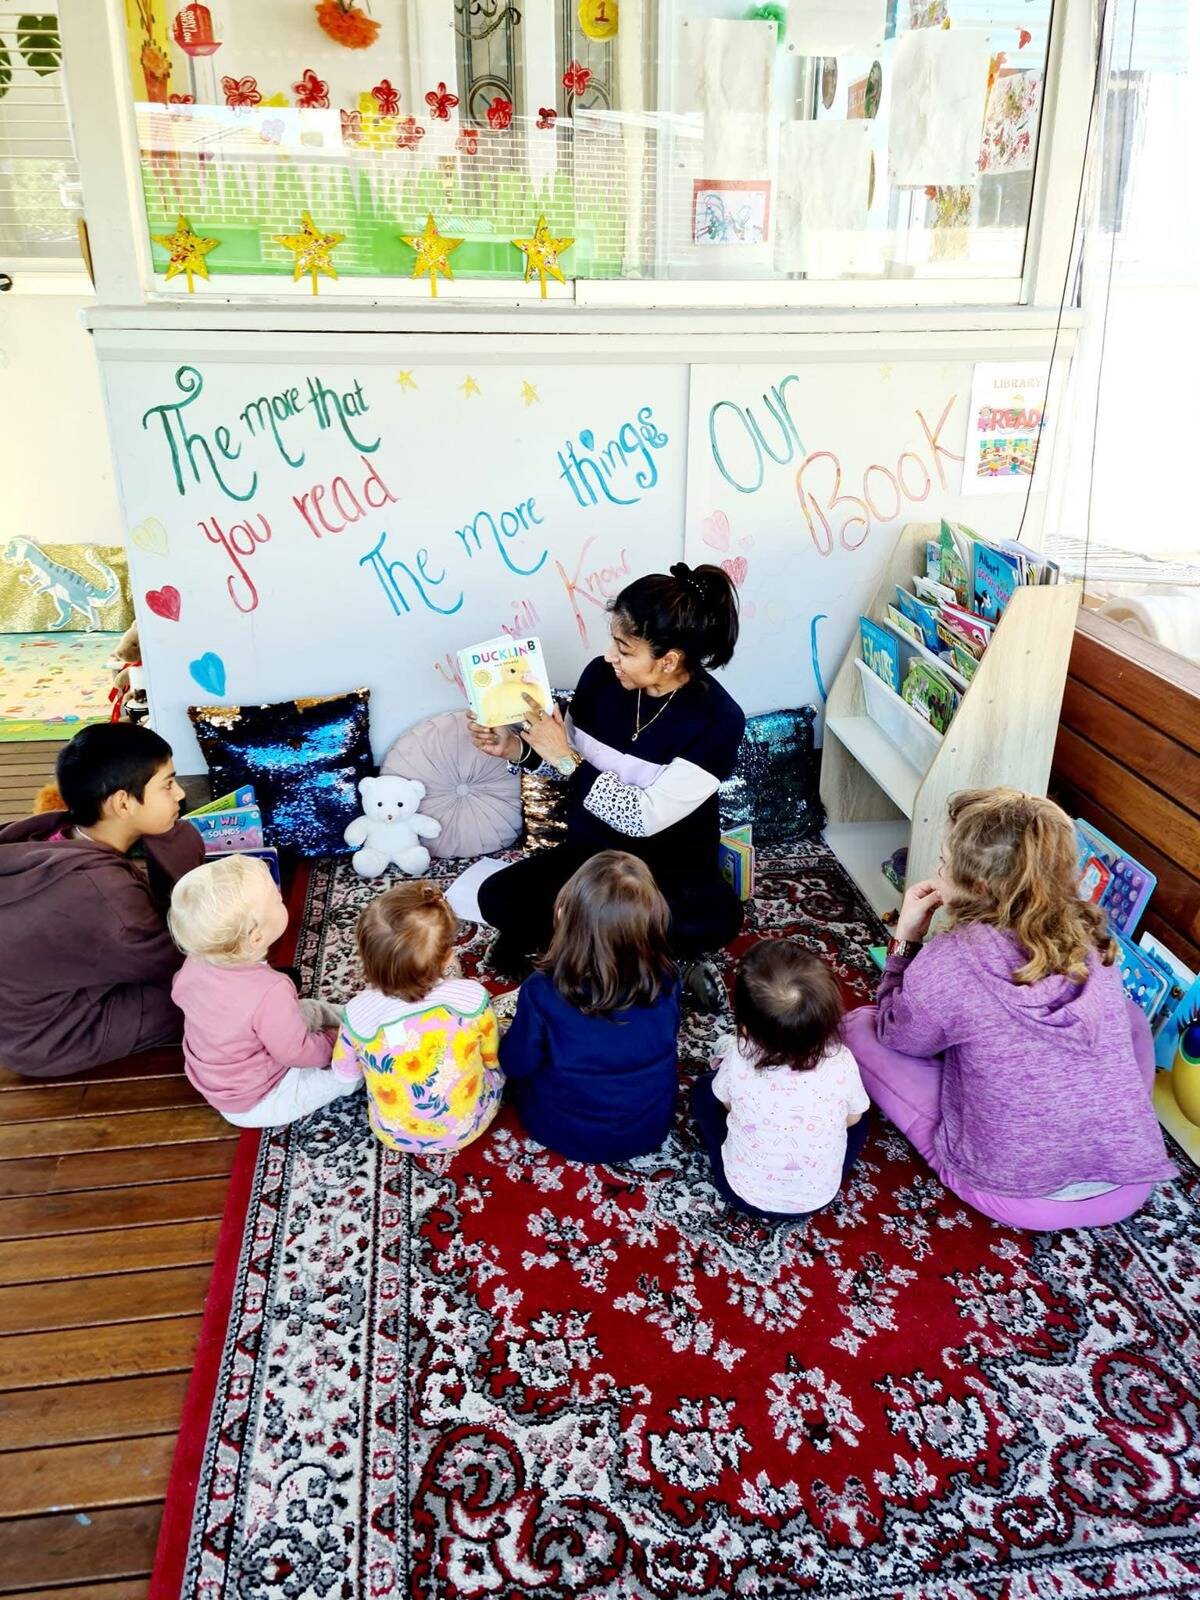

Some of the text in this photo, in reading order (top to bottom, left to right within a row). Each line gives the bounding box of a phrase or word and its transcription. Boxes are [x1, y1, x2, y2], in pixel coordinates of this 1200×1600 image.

[990, 407, 1042, 430] READ
[993, 377, 1041, 389] LIBRARY
[143, 366, 381, 501] The more that
[198, 455, 398, 613] you read
[359, 406, 669, 616] The more things
[208, 827, 240, 838] SOUNDS
